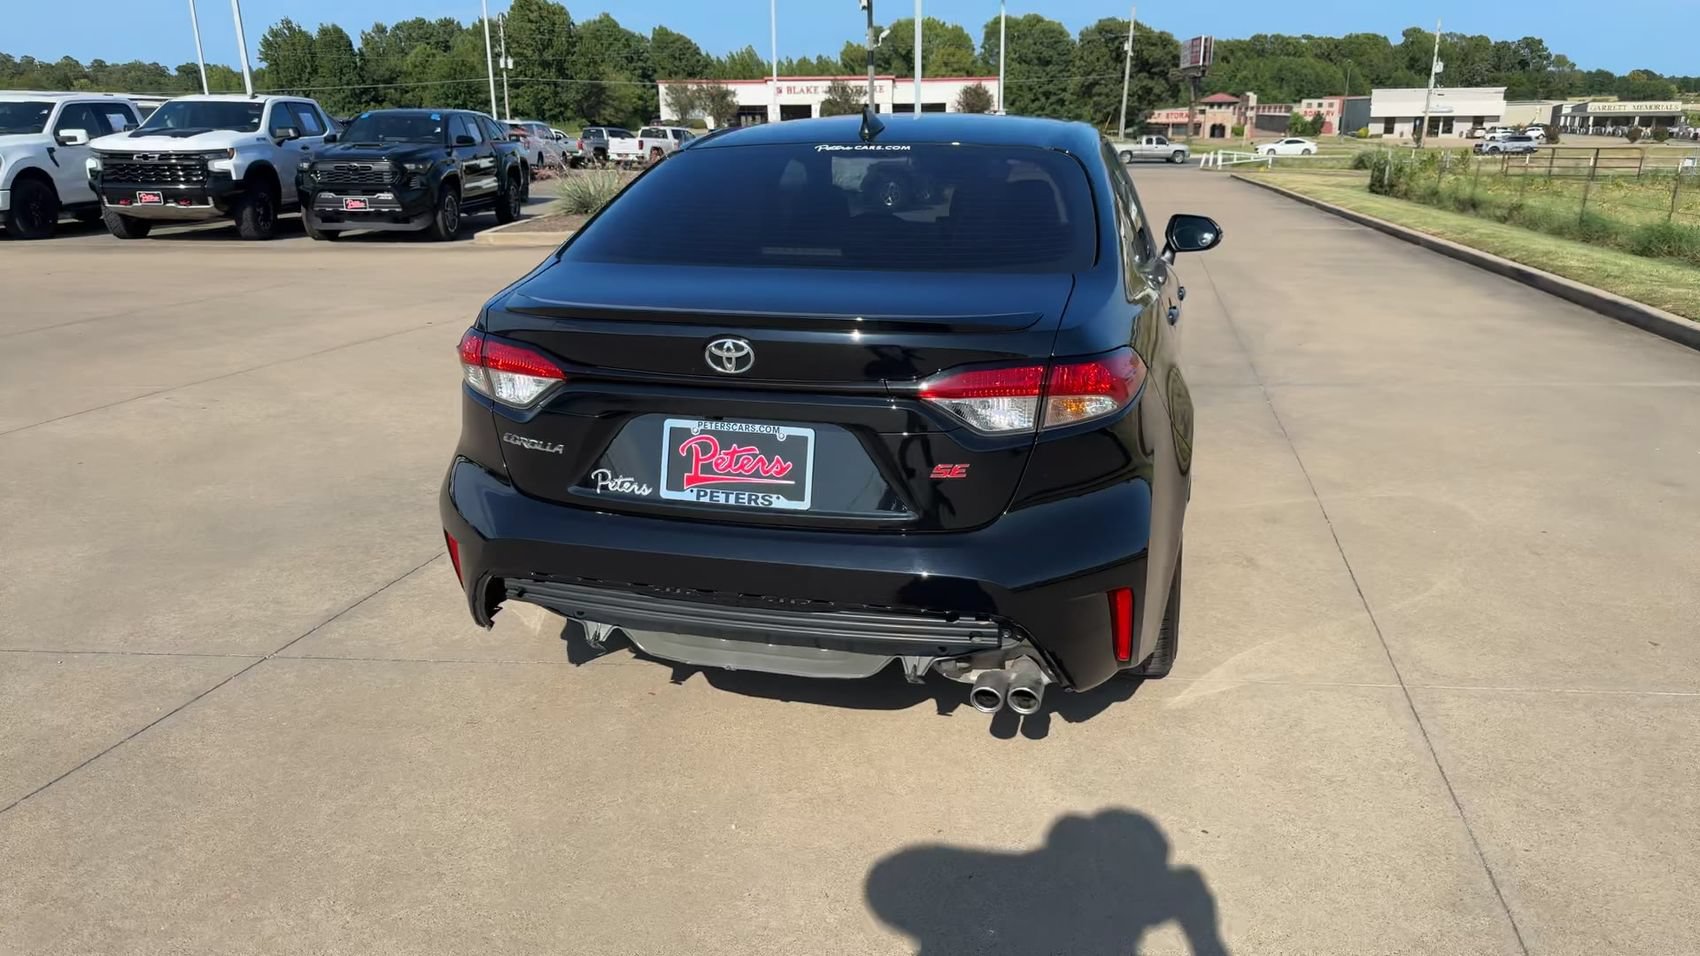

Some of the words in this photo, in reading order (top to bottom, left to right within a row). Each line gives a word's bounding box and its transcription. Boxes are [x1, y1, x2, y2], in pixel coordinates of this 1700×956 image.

[786, 86, 819, 94] BLAKE
[1166, 111, 1199, 119] STORAE
[697, 421, 780, 433] PETERSCARS.COM
[503, 432, 564, 454] COROLLA
[679, 434, 794, 484] Peters
[930, 463, 970, 479] SE
[591, 468, 653, 496] Peters
[695, 489, 773, 507] PETERS
